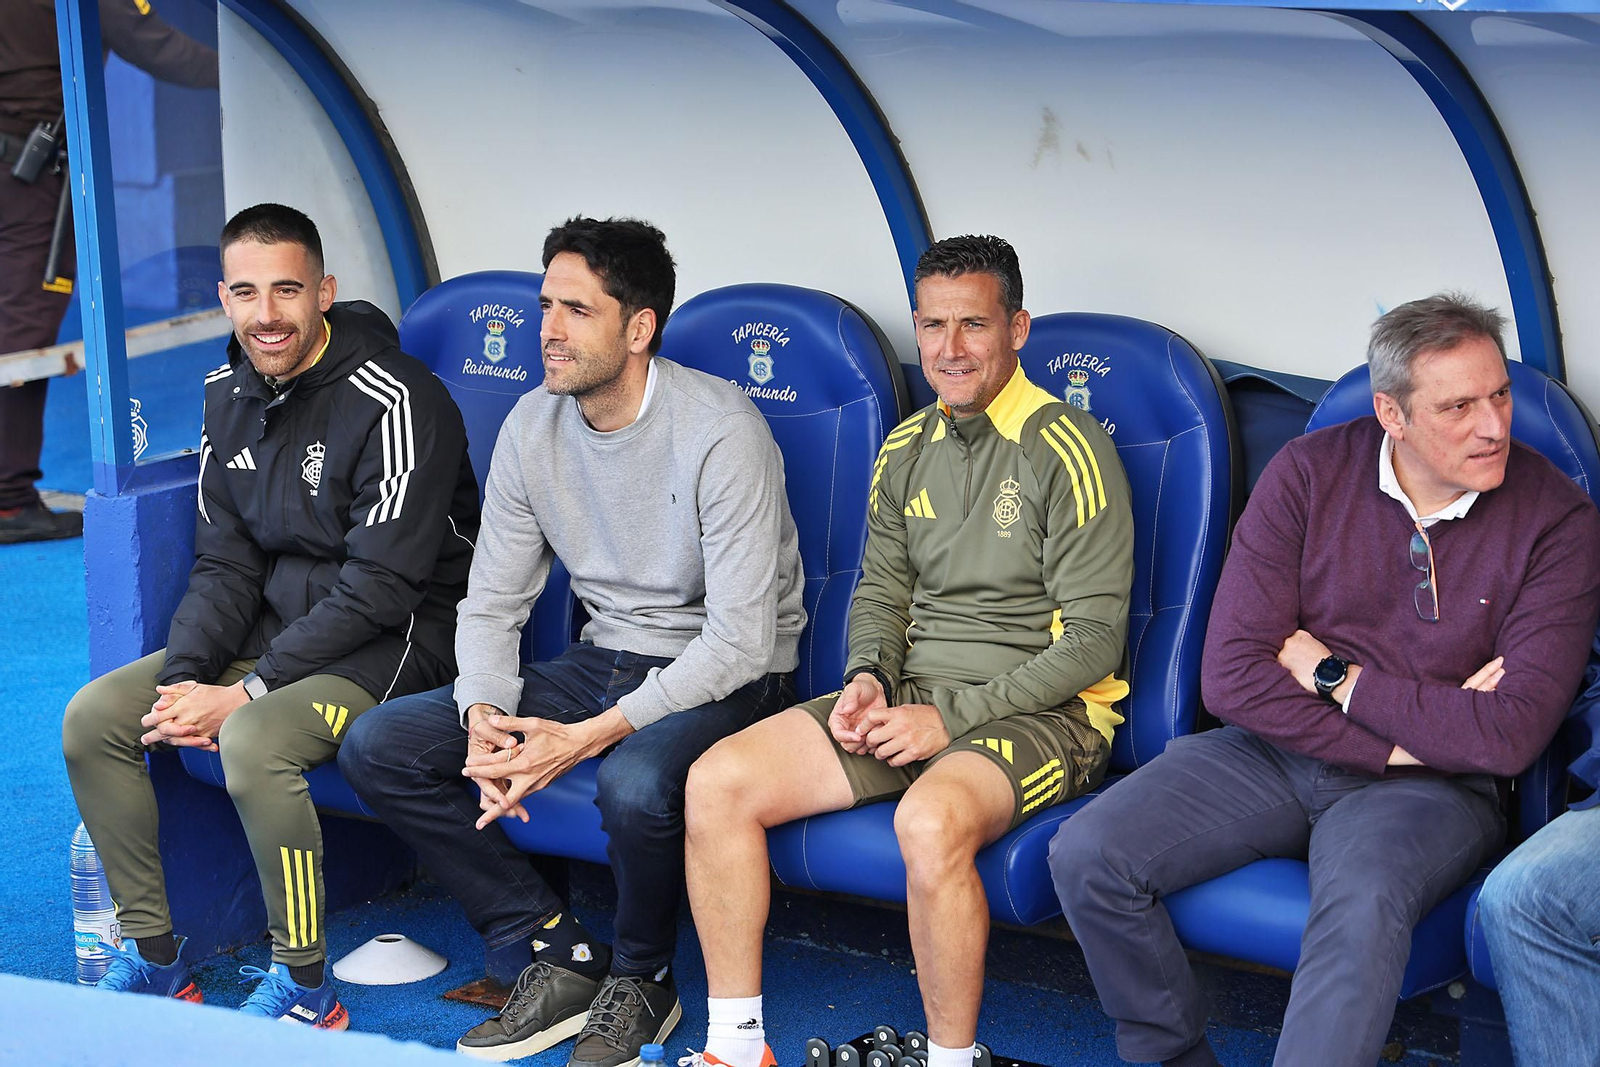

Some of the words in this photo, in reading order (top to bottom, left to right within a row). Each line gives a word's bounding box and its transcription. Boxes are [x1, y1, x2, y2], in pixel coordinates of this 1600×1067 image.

[469, 304, 525, 328] TAPICERÍA
[731, 322, 790, 347] TAPICERÍA
[462, 358, 527, 382] Raimundo
[1046, 352, 1111, 378] TAPICERÍA
